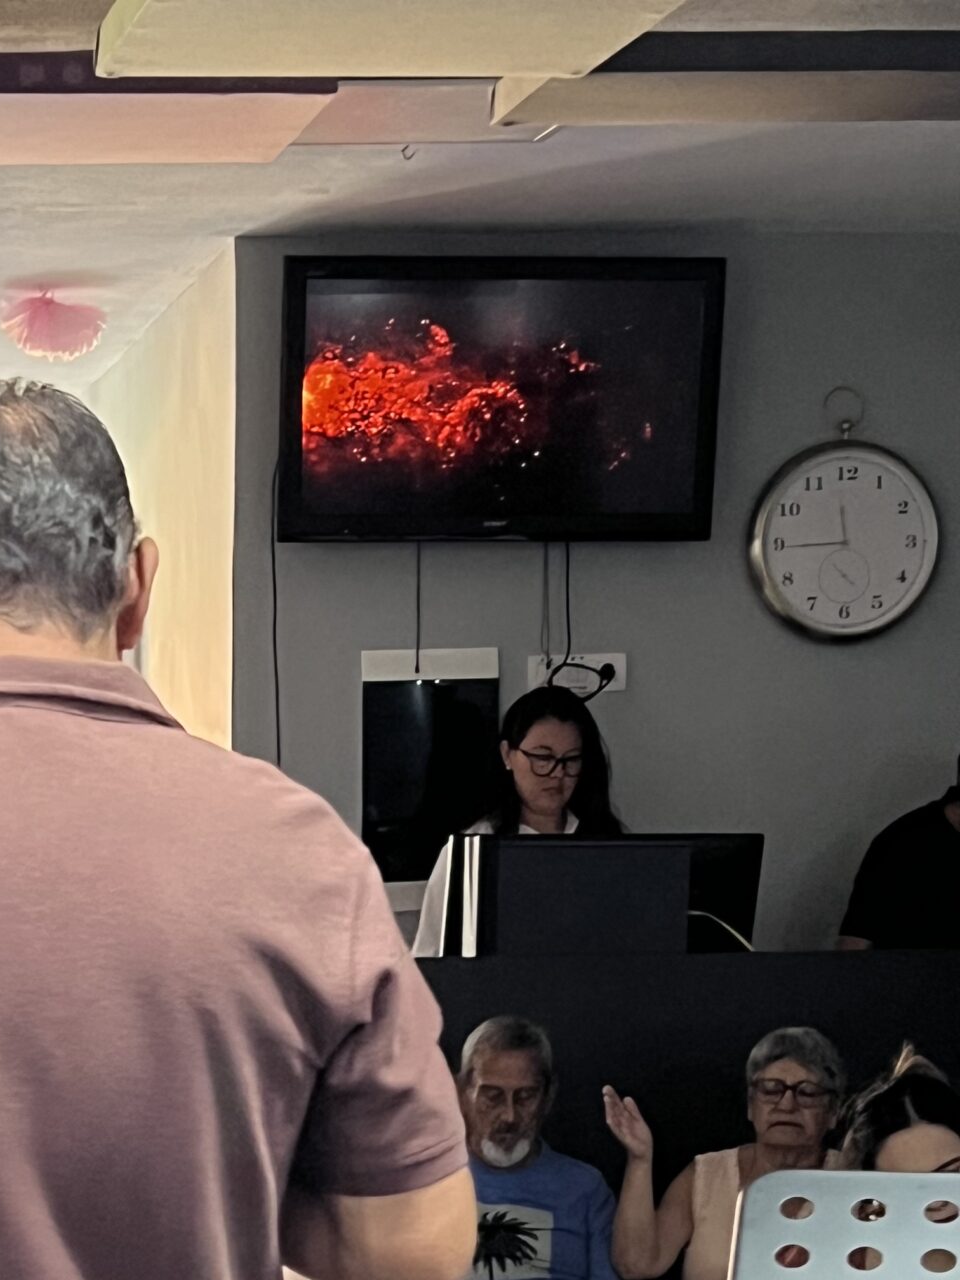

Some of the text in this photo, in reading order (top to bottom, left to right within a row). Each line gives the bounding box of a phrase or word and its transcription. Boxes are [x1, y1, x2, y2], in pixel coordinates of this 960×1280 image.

[837, 466, 859, 481] 12
[804, 476, 823, 492] 11
[875, 475, 883, 490] 1
[779, 502, 801, 517] 10
[897, 500, 909, 514] 2
[773, 537, 785, 551] 9
[905, 534, 917, 549] 3
[782, 571, 794, 586] 8
[896, 569, 907, 583] 4
[806, 596, 818, 611] 7
[871, 595, 883, 610] 5
[838, 604, 851, 619] 6
